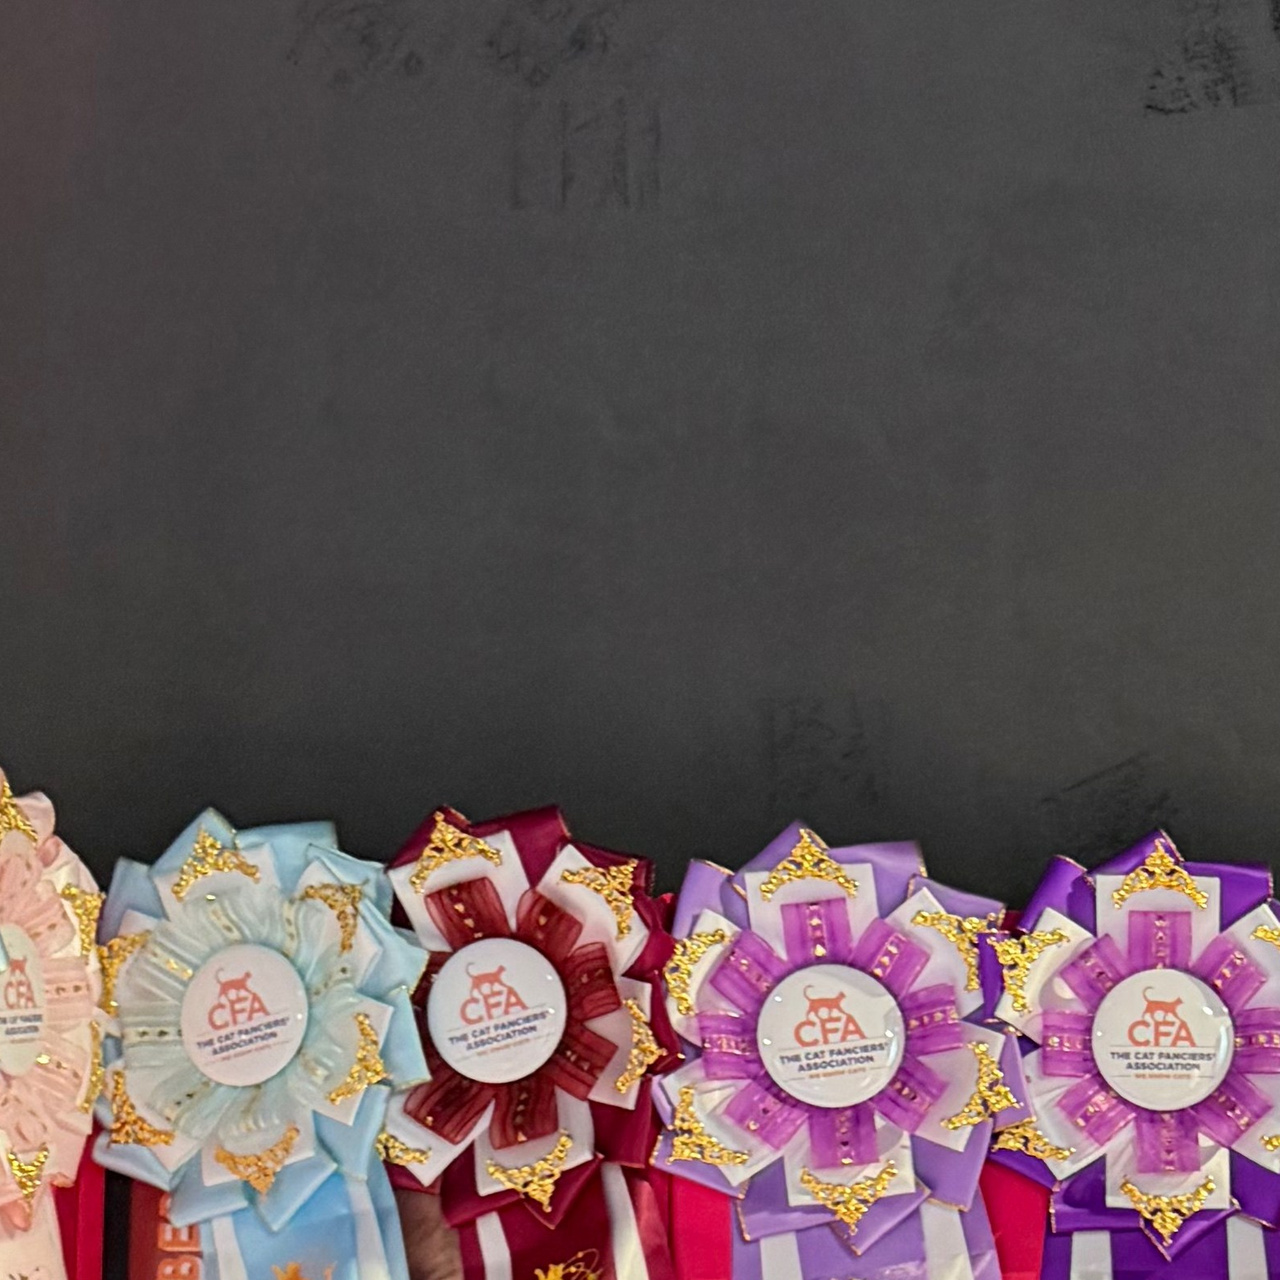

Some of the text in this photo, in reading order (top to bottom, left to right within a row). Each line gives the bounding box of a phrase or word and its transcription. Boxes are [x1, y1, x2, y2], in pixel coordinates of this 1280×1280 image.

[208, 992, 270, 1030] CFA
[460, 986, 530, 1026] CFA
[793, 1013, 868, 1048] CFA
[1127, 1019, 1198, 1047] CFA
[779, 1054, 802, 1065] THE
[804, 1050, 826, 1061] CAT
[798, 1055, 875, 1073] ASSOCIATION
[1110, 1052, 1131, 1061] THE
[1134, 1052, 1155, 1061] CAT
[1125, 1062, 1201, 1071] ASSOCIATION
